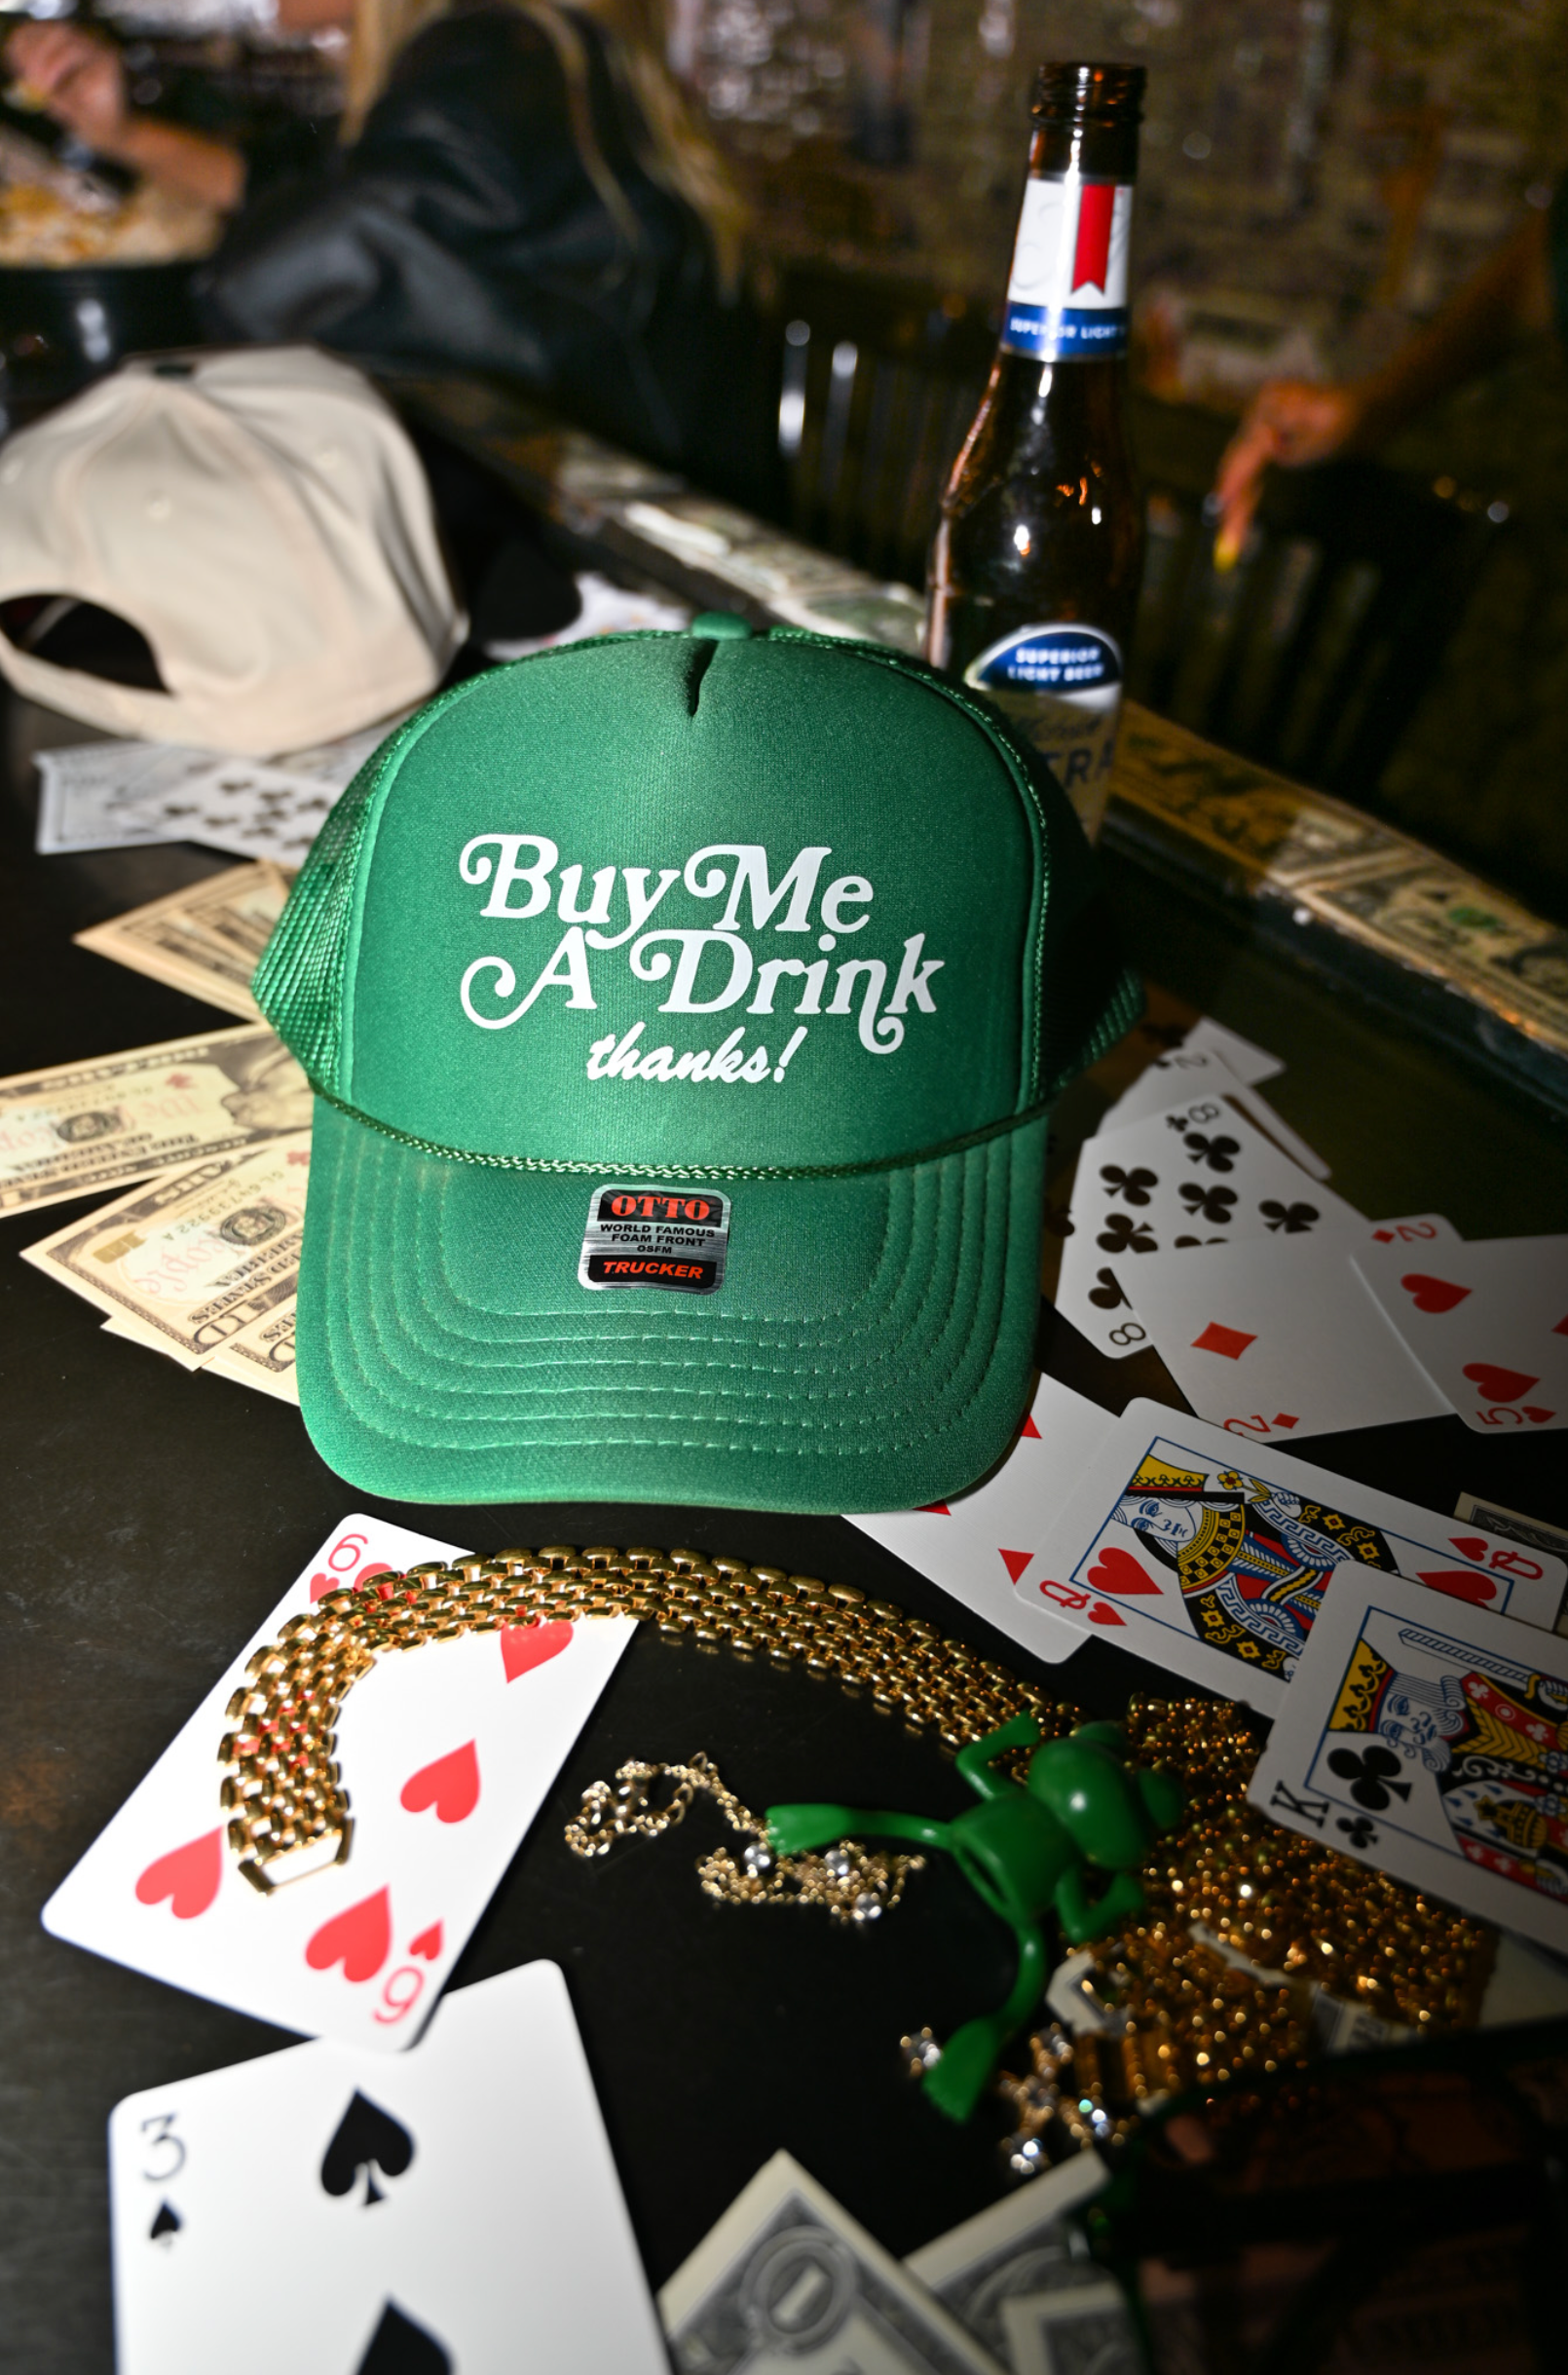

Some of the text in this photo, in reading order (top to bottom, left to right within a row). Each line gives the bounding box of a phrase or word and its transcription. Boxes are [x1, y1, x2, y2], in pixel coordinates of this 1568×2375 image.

[1010, 317, 1077, 339] SUPEROR
[1016, 647, 1101, 663] SUPERIOR
[1007, 664, 1062, 682] LIGHT
[459, 833, 875, 951] Buy Me
[461, 925, 946, 1055] A Drink
[586, 1021, 808, 1083] thanks!
[1188, 1103, 1219, 1124] 8
[611, 1194, 711, 1221] OTTO
[600, 1224, 715, 1237] WORLD FAMOUS
[612, 1233, 706, 1247] FOAM FRONT
[1395, 1222, 1438, 1243] 2
[636, 1245, 672, 1254] OSFM
[603, 1261, 704, 1279] TRUCKER
[1108, 1322, 1146, 1346] 8
[1475, 1406, 1524, 1426] 5
[327, 1532, 369, 1572] 6
[1488, 1550, 1544, 1580] Q
[1038, 1579, 1092, 1610] Q
[1269, 1779, 1330, 1828] K
[140, 2111, 188, 2182] 3
